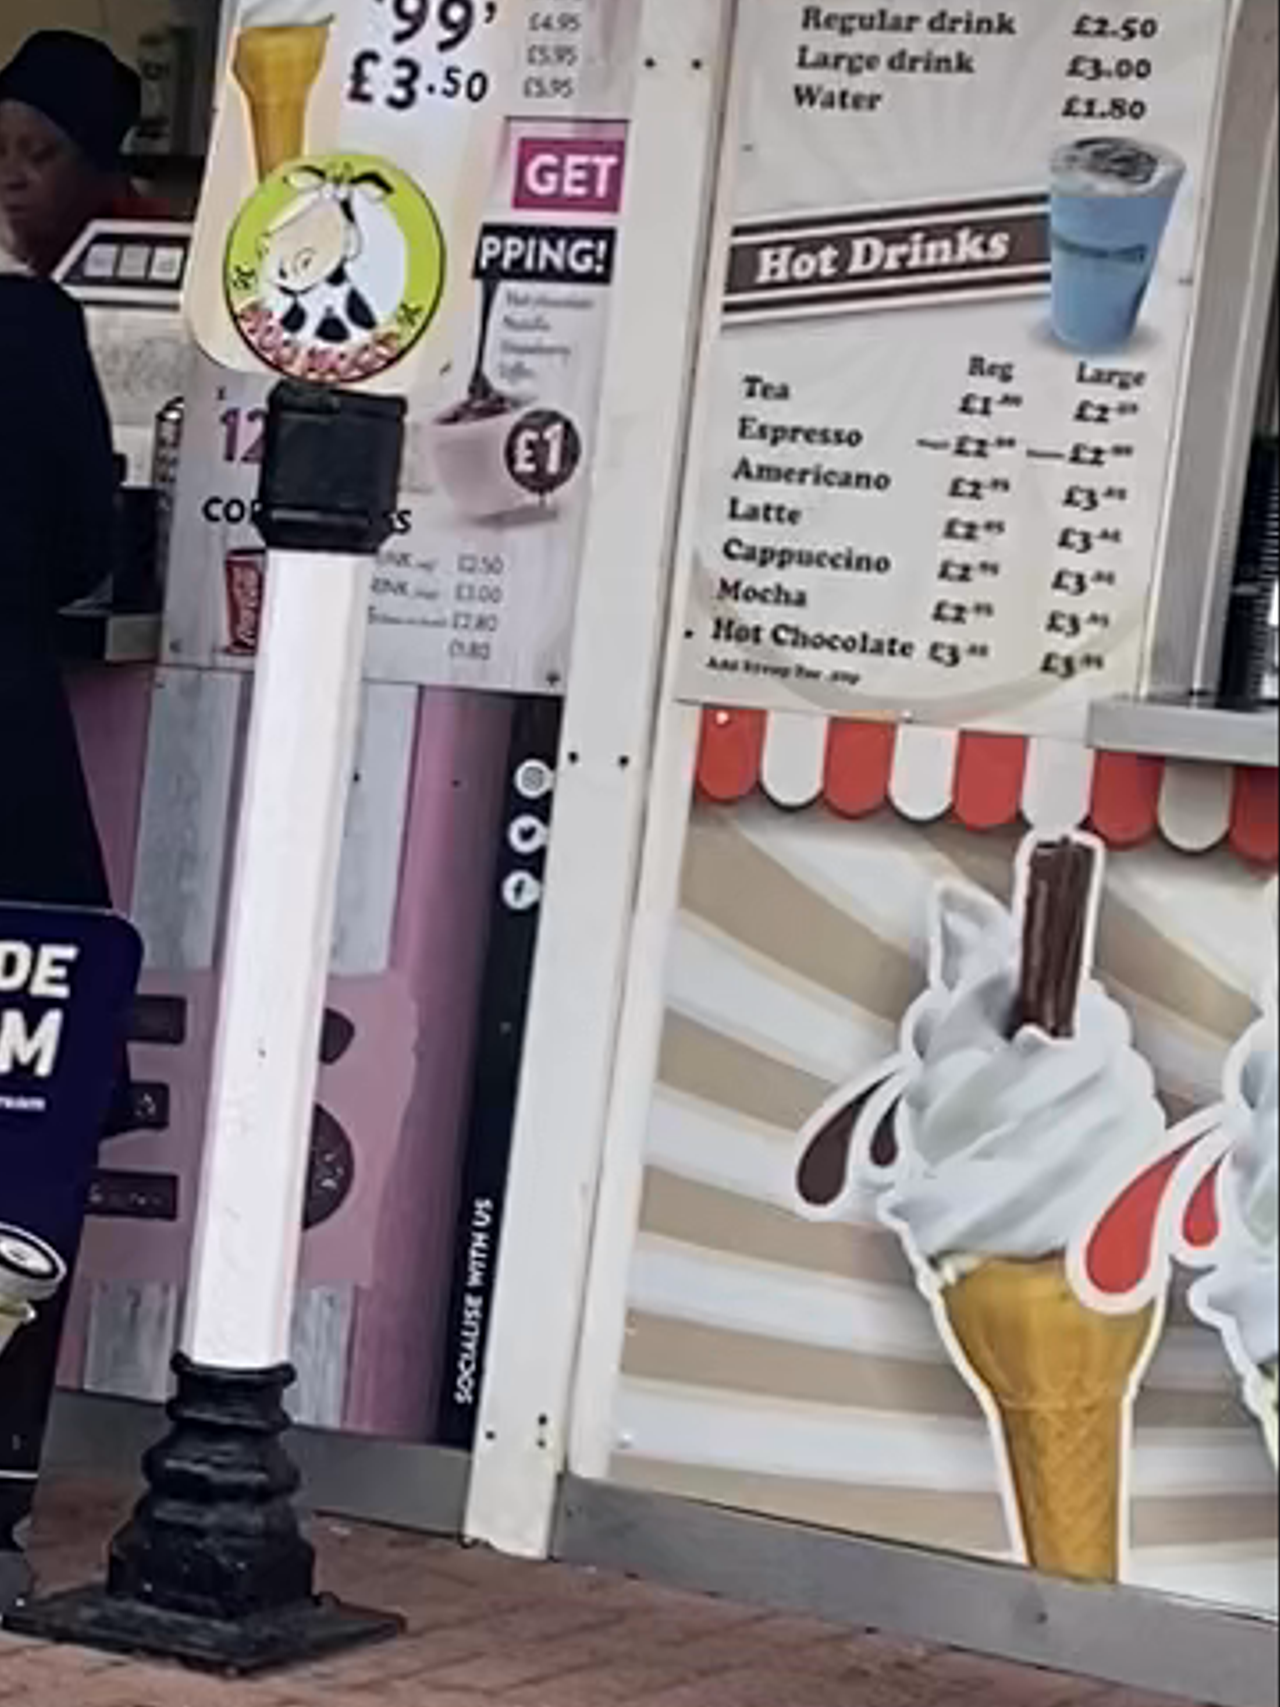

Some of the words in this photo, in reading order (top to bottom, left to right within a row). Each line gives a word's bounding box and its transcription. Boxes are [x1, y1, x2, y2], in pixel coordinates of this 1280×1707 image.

[528, 12, 581, 32] £4.95
[801, 6, 921, 37] Regular
[927, 10, 1017, 35] drink
[1072, 15, 1158, 40] £2.50
[348, 50, 489, 111] £3.50
[796, 45, 880, 76] Large
[886, 49, 975, 75] drink
[1066, 55, 1151, 80] £3.00
[792, 84, 882, 113] Water
[1061, 97, 1147, 121] £1.80
[525, 154, 618, 198] GET
[480, 236, 607, 274] PPING!
[756, 244, 839, 284] Hot
[848, 227, 1010, 275] Drinks
[743, 375, 790, 400] Tea
[968, 355, 1014, 383] Reg
[1076, 361, 1146, 390] Large
[511, 421, 564, 476] £1
[738, 415, 863, 446] Espresso
[732, 456, 892, 491] Americano
[727, 496, 802, 525] Latte
[722, 537, 892, 574] Cappuccino
[716, 577, 807, 607] Mocha
[711, 617, 763, 645] Hot
[770, 624, 915, 658] Chocolate
[471, 1197, 493, 1228] US
[466, 1230, 490, 1287] WITH
[453, 1294, 483, 1405] SOCIALISE
